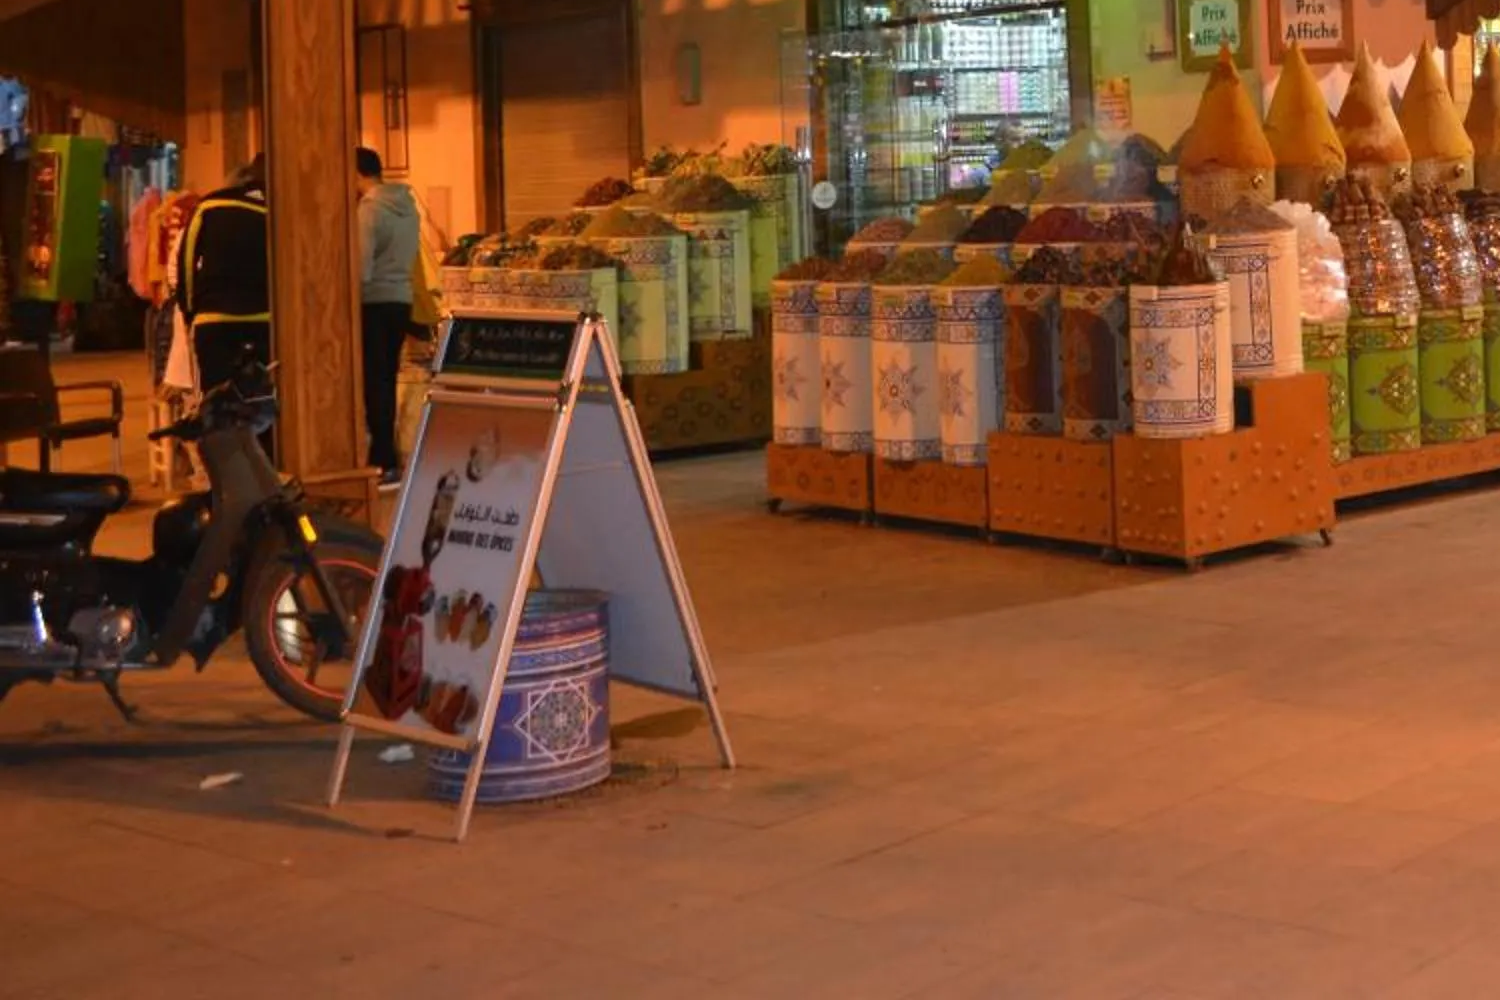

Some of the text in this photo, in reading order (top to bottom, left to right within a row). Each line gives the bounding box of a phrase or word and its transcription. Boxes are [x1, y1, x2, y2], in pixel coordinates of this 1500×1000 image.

[1201, 4, 1226, 21] Prix
[1193, 28, 1236, 47] Afficé
[1285, 20, 1339, 40] Affiché
